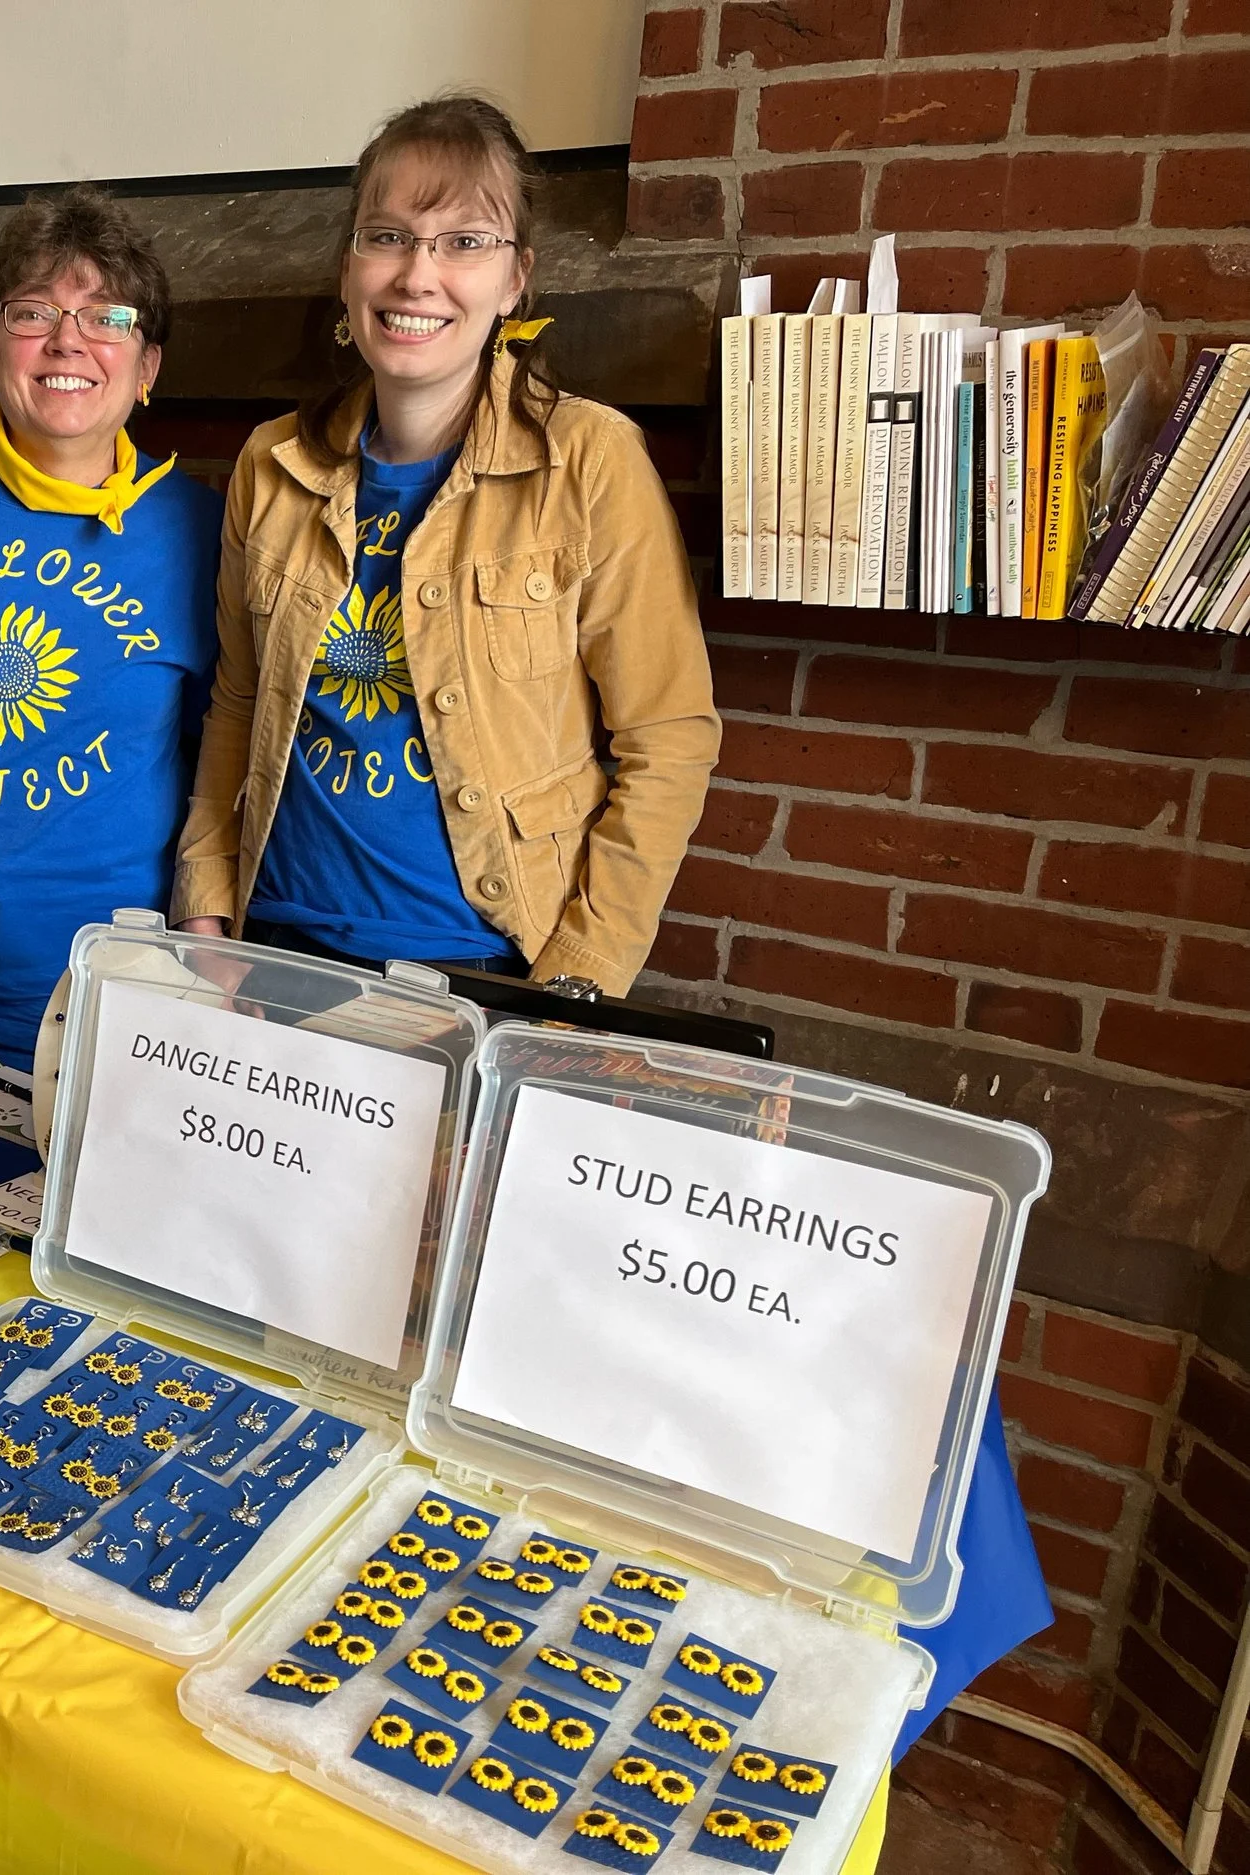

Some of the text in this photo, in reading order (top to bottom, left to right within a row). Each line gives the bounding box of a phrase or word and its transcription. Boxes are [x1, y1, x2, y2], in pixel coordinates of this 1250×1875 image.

[763, 327, 771, 345] THE
[794, 328, 802, 345] THE
[822, 327, 830, 345] THE
[852, 328, 861, 346] THE
[877, 333, 889, 387] MALLON
[902, 334, 913, 388] MALLON
[730, 352, 738, 391] HUNNY
[762, 349, 770, 387] HUNNY
[792, 350, 800, 388] HUNNY
[820, 349, 829, 388] HUNNY
[850, 351, 859, 390] HUNNY
[1031, 360, 1040, 411] MATTHEW KELLY
[1173, 364, 1207, 423] MATTHEW KELLY
[874, 429, 887, 478] DIVINE
[1002, 370, 1020, 490] the generosity habit
[731, 445, 739, 485] MEMOIR
[761, 443, 769, 483] MEMOIR
[789, 445, 798, 485] MEMOIR
[815, 446, 824, 486] MEMOIR
[844, 448, 853, 489] MEMOIR
[1048, 416, 1066, 552] RESISTING HAPPINESS
[1234, 470, 1243, 481] OF
[894, 430, 911, 582] DIVINE RENOVATION
[1120, 452, 1166, 528] Rediscover Jesus
[1212, 482, 1235, 517] FULTON
[730, 520, 739, 588] JACK MURTHA
[760, 518, 768, 587] JACK MURTHA
[786, 520, 795, 590] JACK MURTHA
[811, 522, 821, 592] JACK MURTHA
[868, 484, 883, 581] RENOVATION
[1007, 524, 1018, 584] matthew kelly
[1193, 519, 1214, 547] SHEEN
[838, 524, 849, 595] JACK MURTHA
[130, 1033, 396, 1129] DANGLE EARRINGS
[179, 1105, 312, 1175] $8.00 EA.
[567, 1153, 900, 1268] STUD EARRINGS
[617, 1239, 801, 1325] $5.00 EA.
